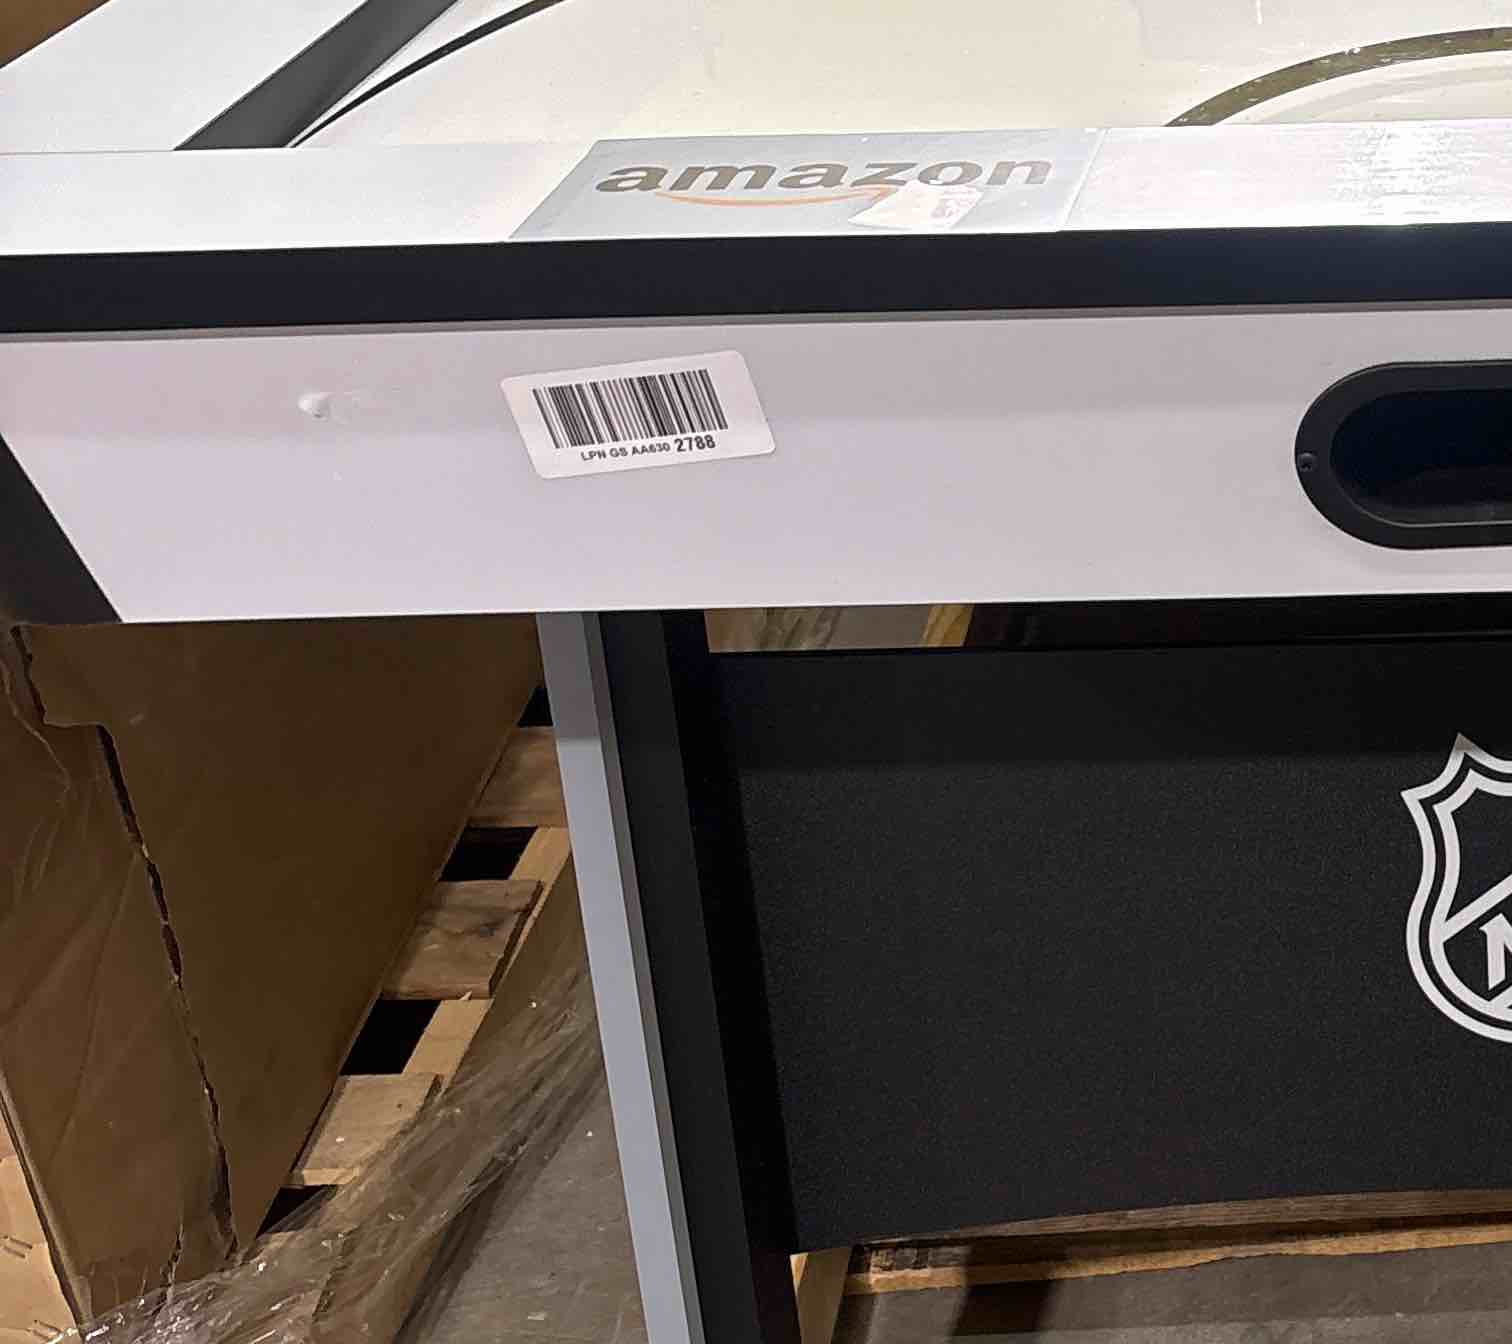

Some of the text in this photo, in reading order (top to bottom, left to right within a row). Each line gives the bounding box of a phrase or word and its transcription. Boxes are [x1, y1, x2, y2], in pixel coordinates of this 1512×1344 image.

[593, 159, 1055, 193] amazon
[580, 446, 607, 462] LPN
[674, 432, 716, 454] 2788
